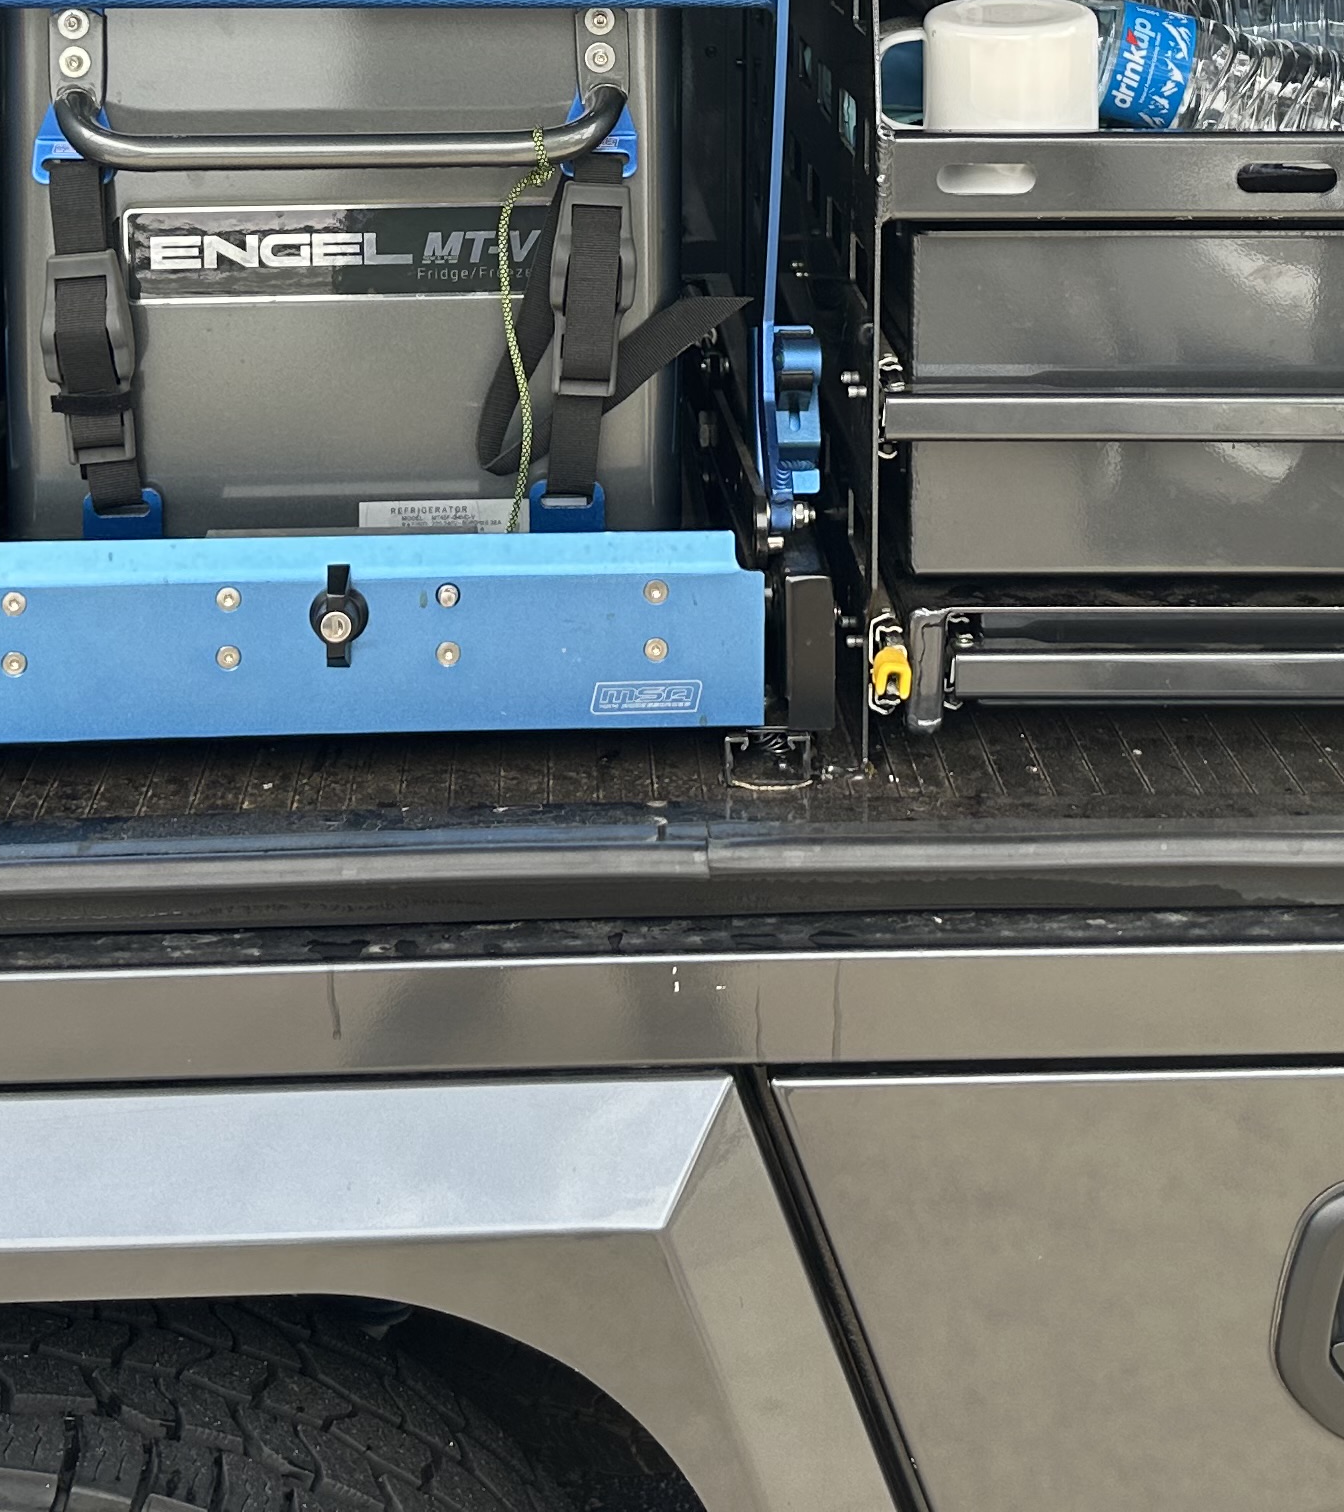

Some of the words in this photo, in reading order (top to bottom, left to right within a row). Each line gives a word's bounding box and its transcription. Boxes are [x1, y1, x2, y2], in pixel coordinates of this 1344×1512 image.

[150, 232, 413, 270] ENGEL
[422, 230, 541, 263] MT-V
[390, 506, 468, 514] REFRIGERATOR
